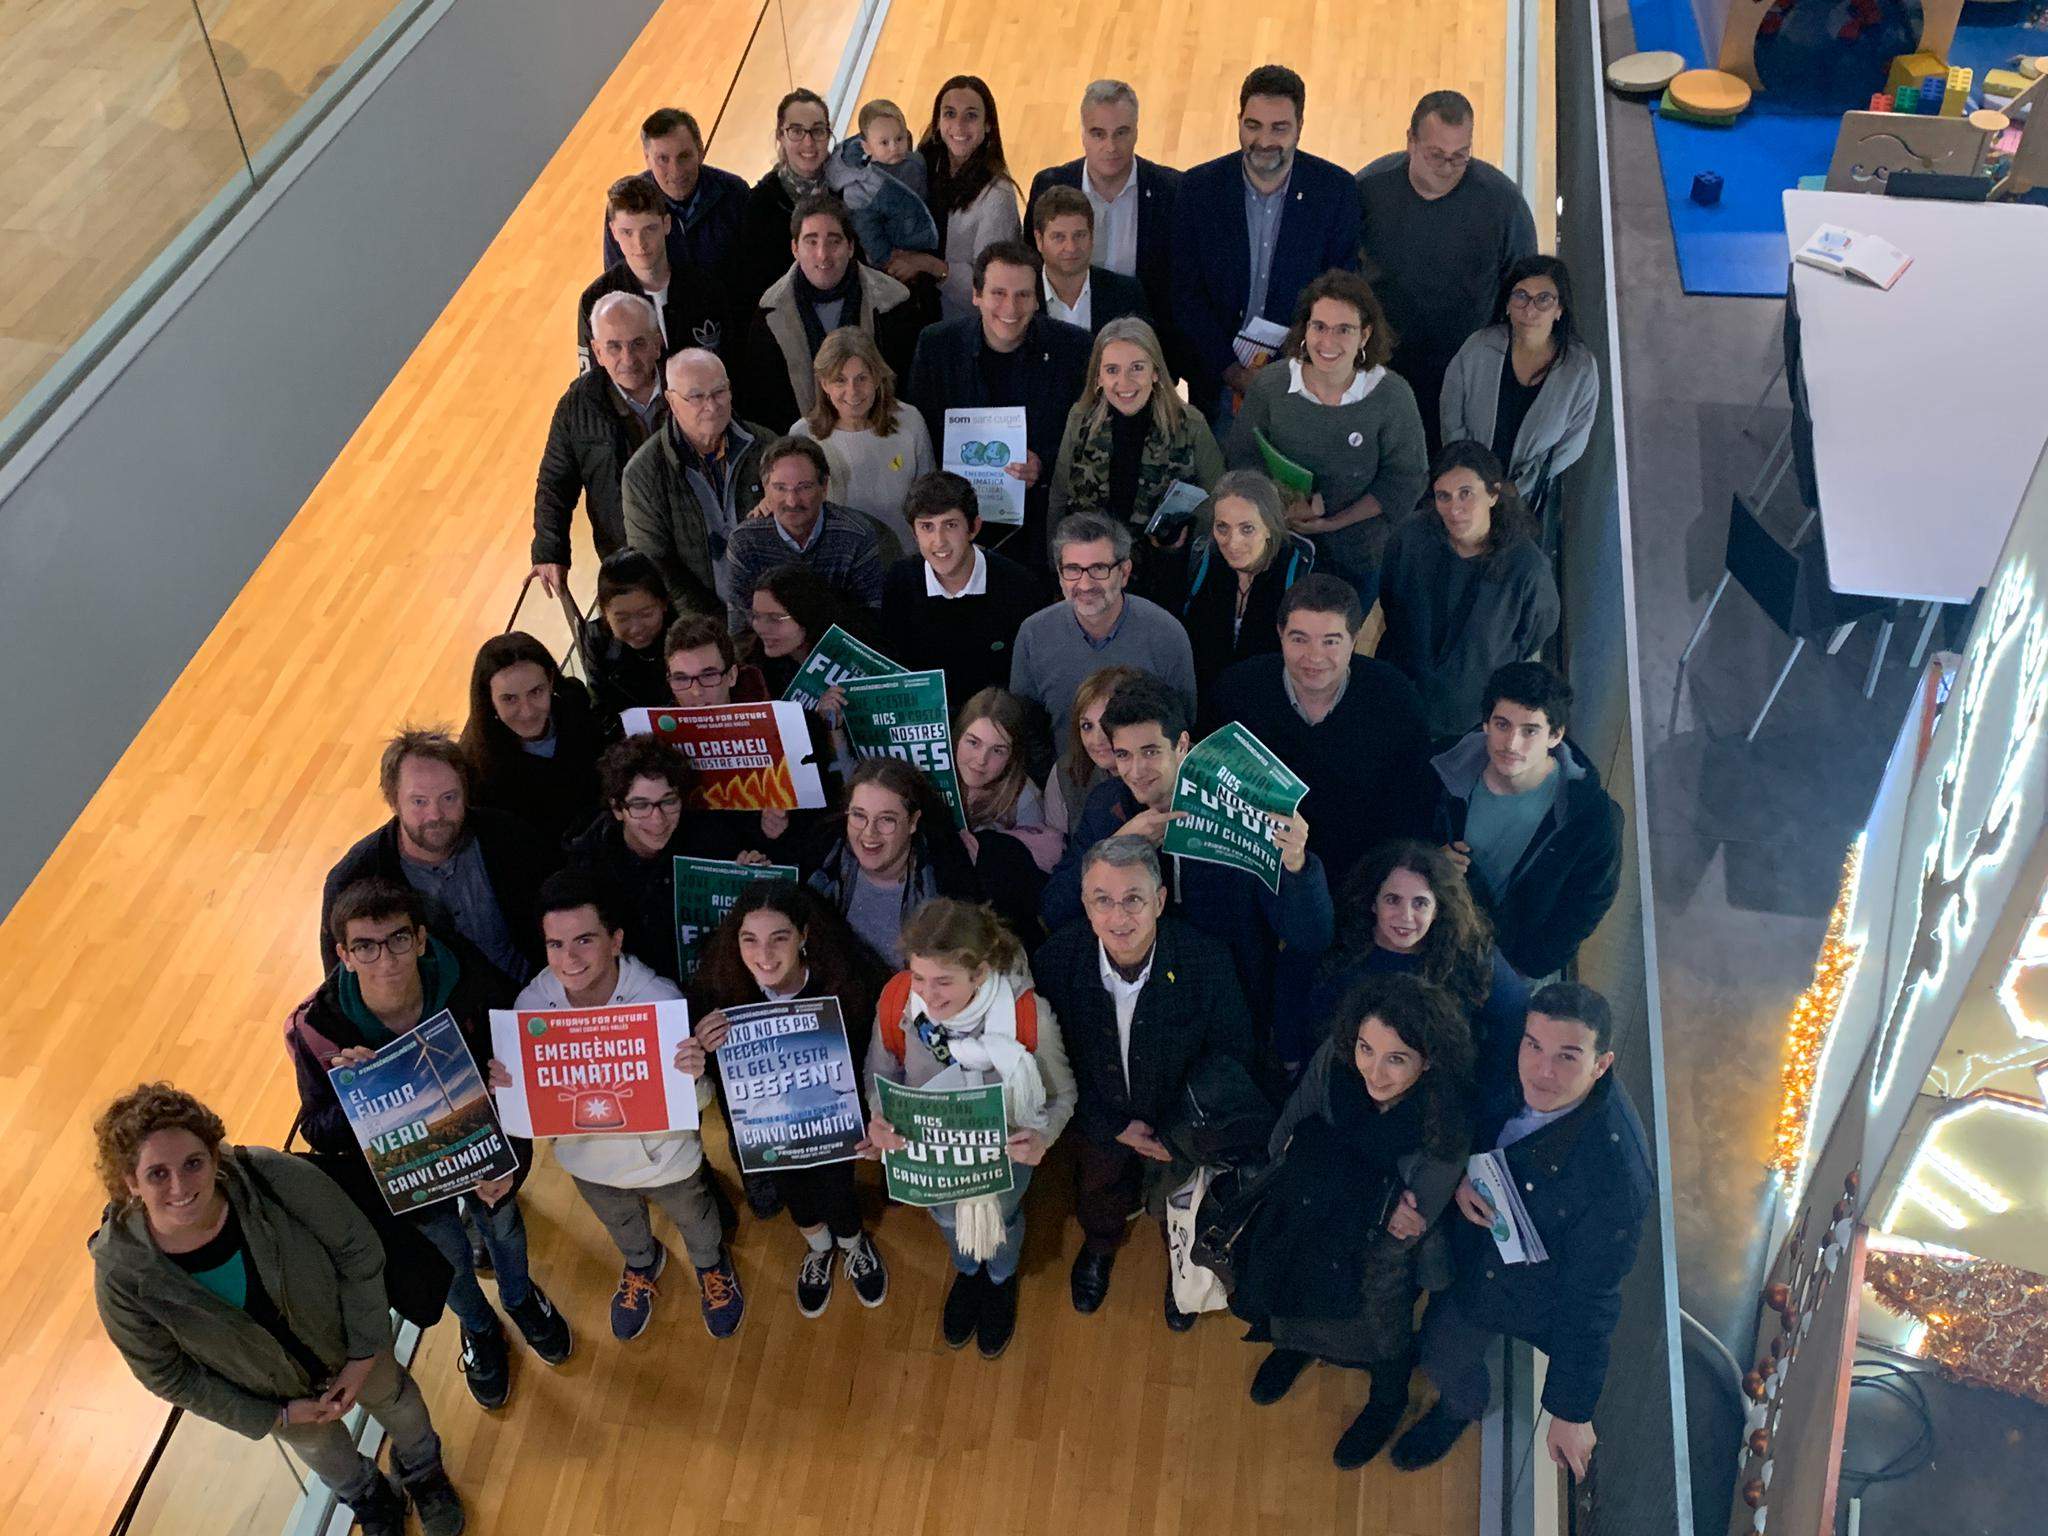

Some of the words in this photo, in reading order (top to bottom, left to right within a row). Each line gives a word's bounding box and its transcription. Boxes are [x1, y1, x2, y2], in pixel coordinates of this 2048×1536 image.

[948, 416, 971, 424] som
[791, 688, 818, 711] CAN
[716, 714, 733, 722] FOR
[735, 712, 767, 721] FUTURE
[873, 712, 896, 726] RICS
[891, 725, 945, 741] NOSTRES
[700, 738, 767, 757] CREMEU
[737, 756, 771, 768] FUTUR
[1216, 766, 1242, 792] RICS
[1180, 777, 1278, 843] FUTUR
[1176, 815, 1219, 835] CANVI
[1222, 829, 1277, 872] CLIMÀTIC
[550, 1016, 590, 1027] FRIDAYS
[592, 1016, 610, 1025] FOR
[613, 1013, 649, 1025] FUTURE
[725, 1026, 751, 1045] IXO
[755, 1023, 772, 1038] NO
[793, 1015, 818, 1031] PAS
[534, 1036, 647, 1062] EMERGÈNCIA
[725, 1039, 783, 1062] RECENT,
[537, 1058, 650, 1087] CLIMÀTICA
[727, 1066, 744, 1080] EL
[748, 1059, 775, 1076] GEL
[731, 1061, 843, 1100] DESFENT
[349, 1088, 367, 1105] EL
[355, 1082, 416, 1120] FUTUR
[743, 1128, 787, 1145] CANVI
[790, 1113, 855, 1139] CLIMÀTIC
[913, 1114, 942, 1127] RICS
[370, 1120, 429, 1155] VERD
[923, 1129, 1000, 1145] NOSTRE
[388, 1169, 434, 1195] CANVI
[435, 1134, 502, 1178] CLIMÀTIC
[889, 1140, 1000, 1166] UTUR
[892, 1167, 933, 1188] CANVI
[937, 1168, 1003, 1189] CLIMÀTIC
